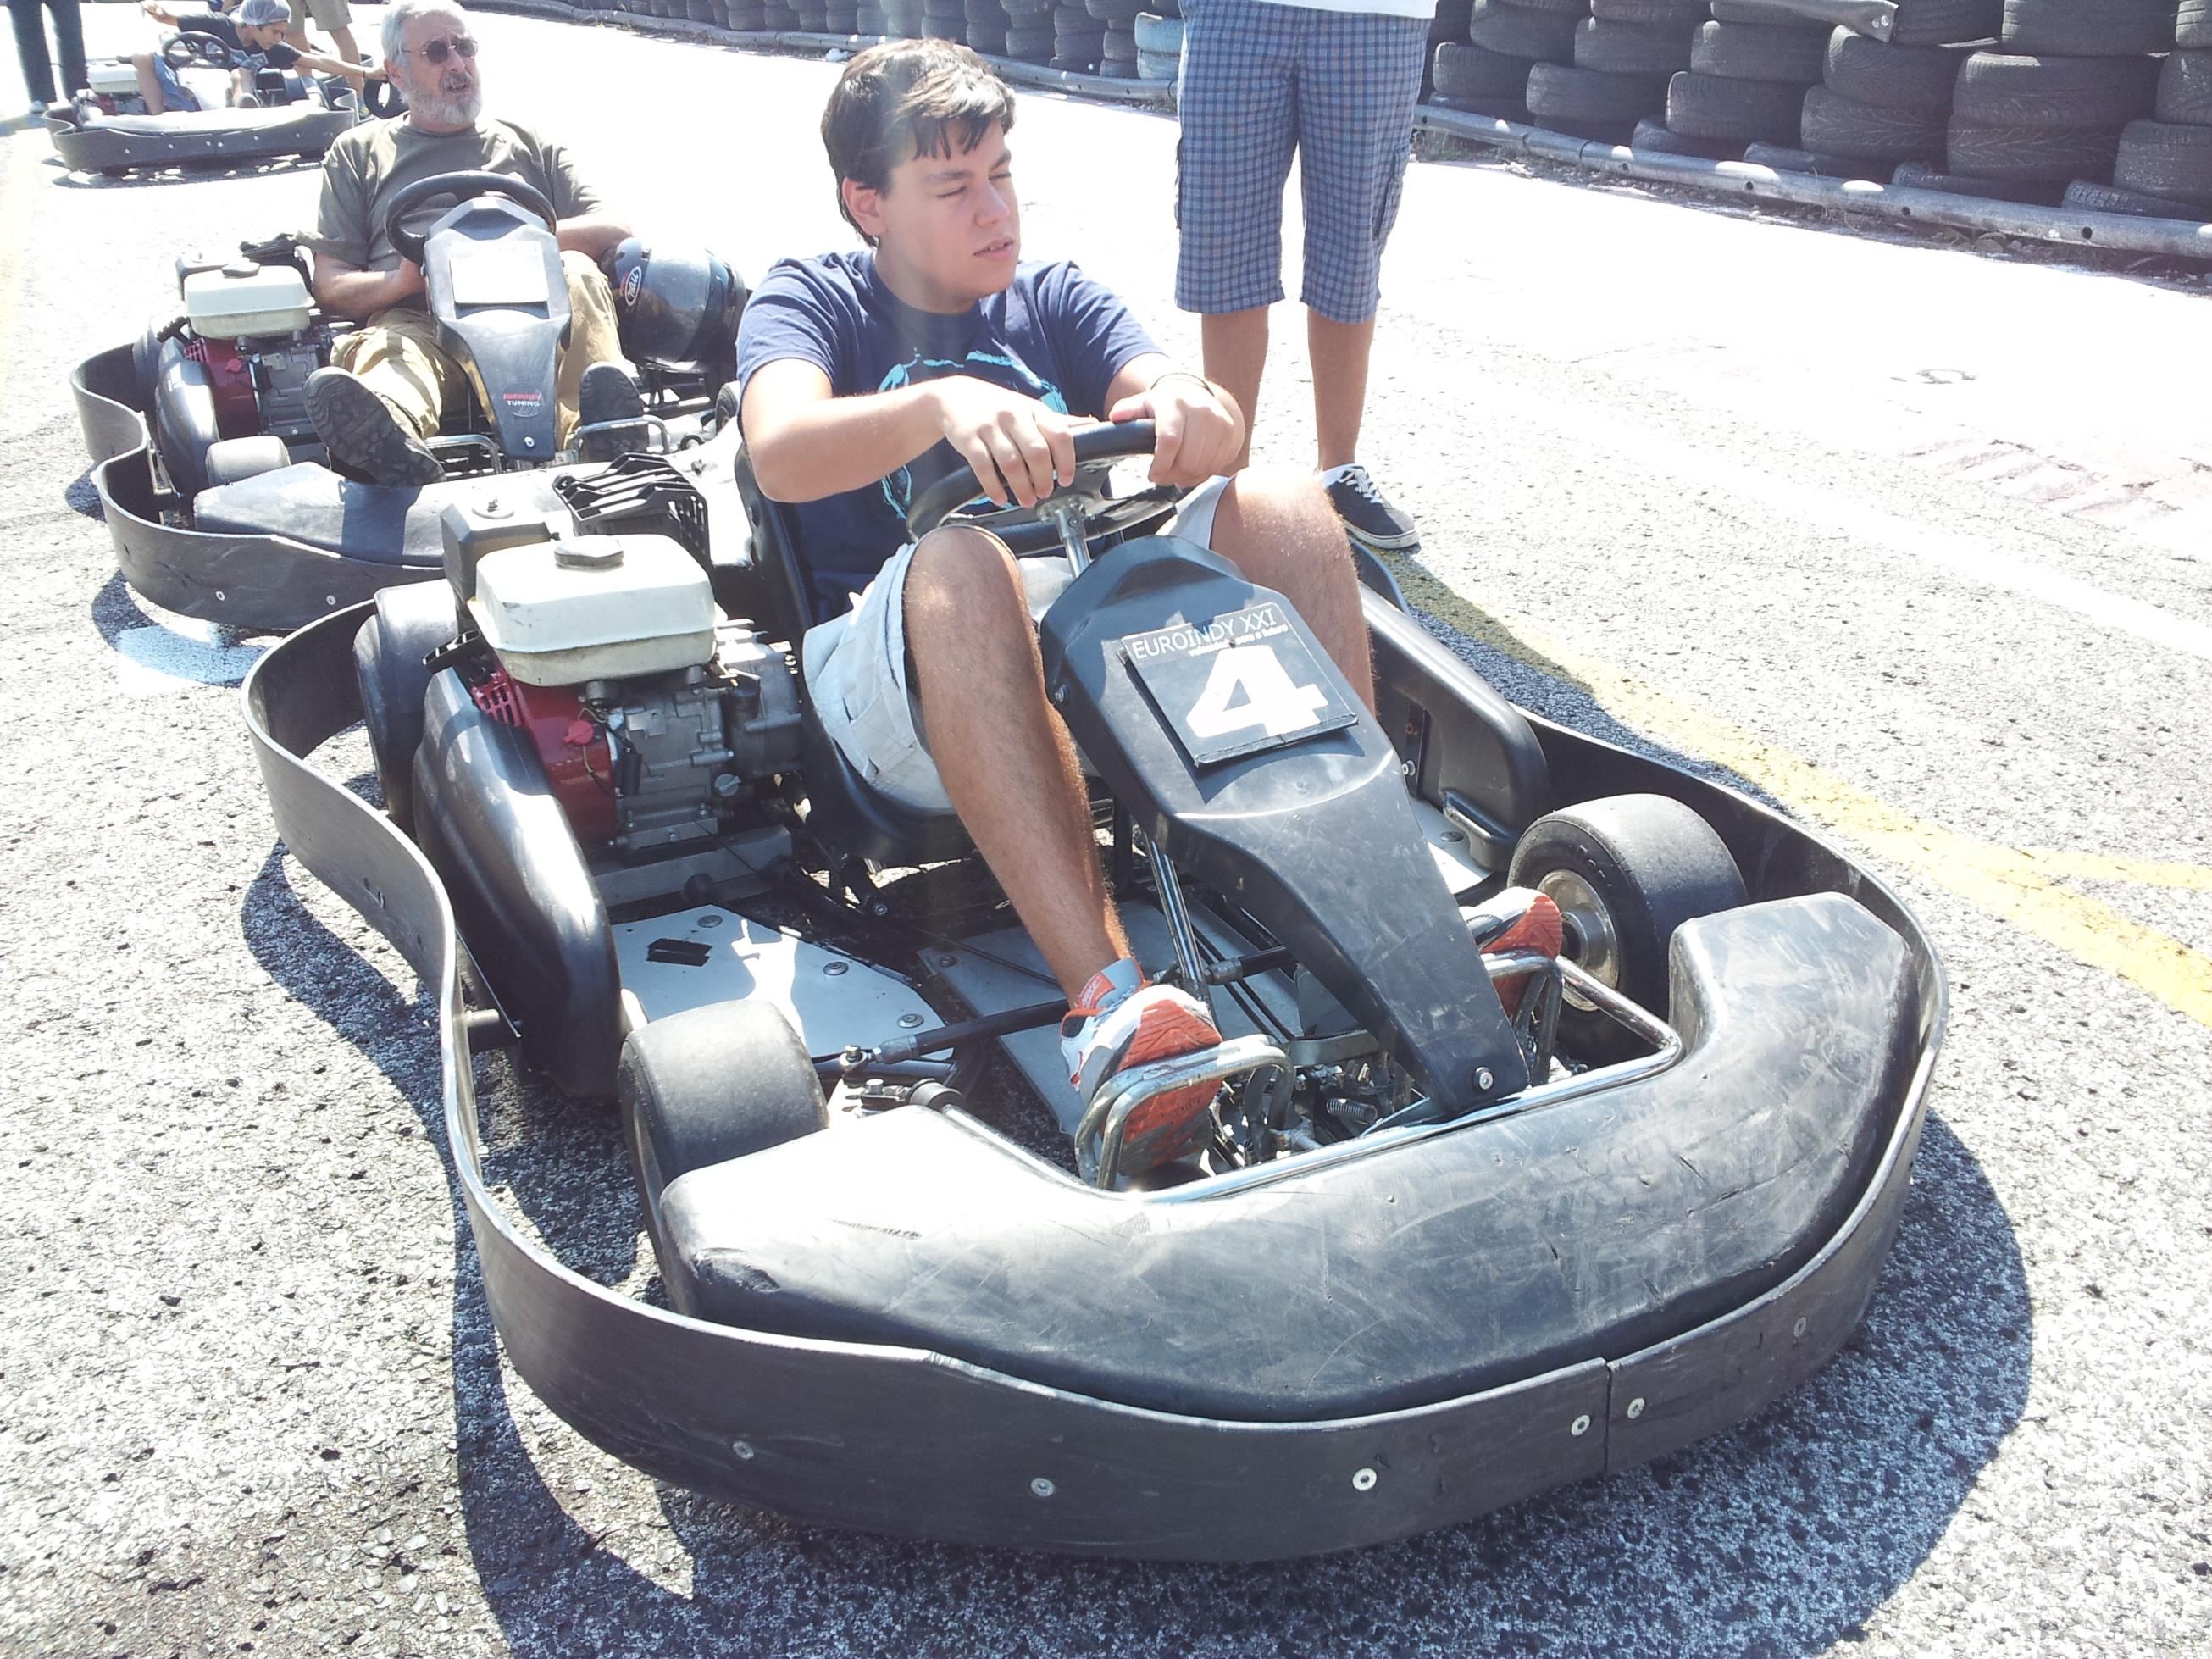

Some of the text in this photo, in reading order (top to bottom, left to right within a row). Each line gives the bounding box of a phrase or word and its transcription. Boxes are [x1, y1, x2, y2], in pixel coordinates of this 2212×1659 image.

[1132, 608, 1277, 659] EUROINDY XXI
[1185, 644, 1328, 738] 4
